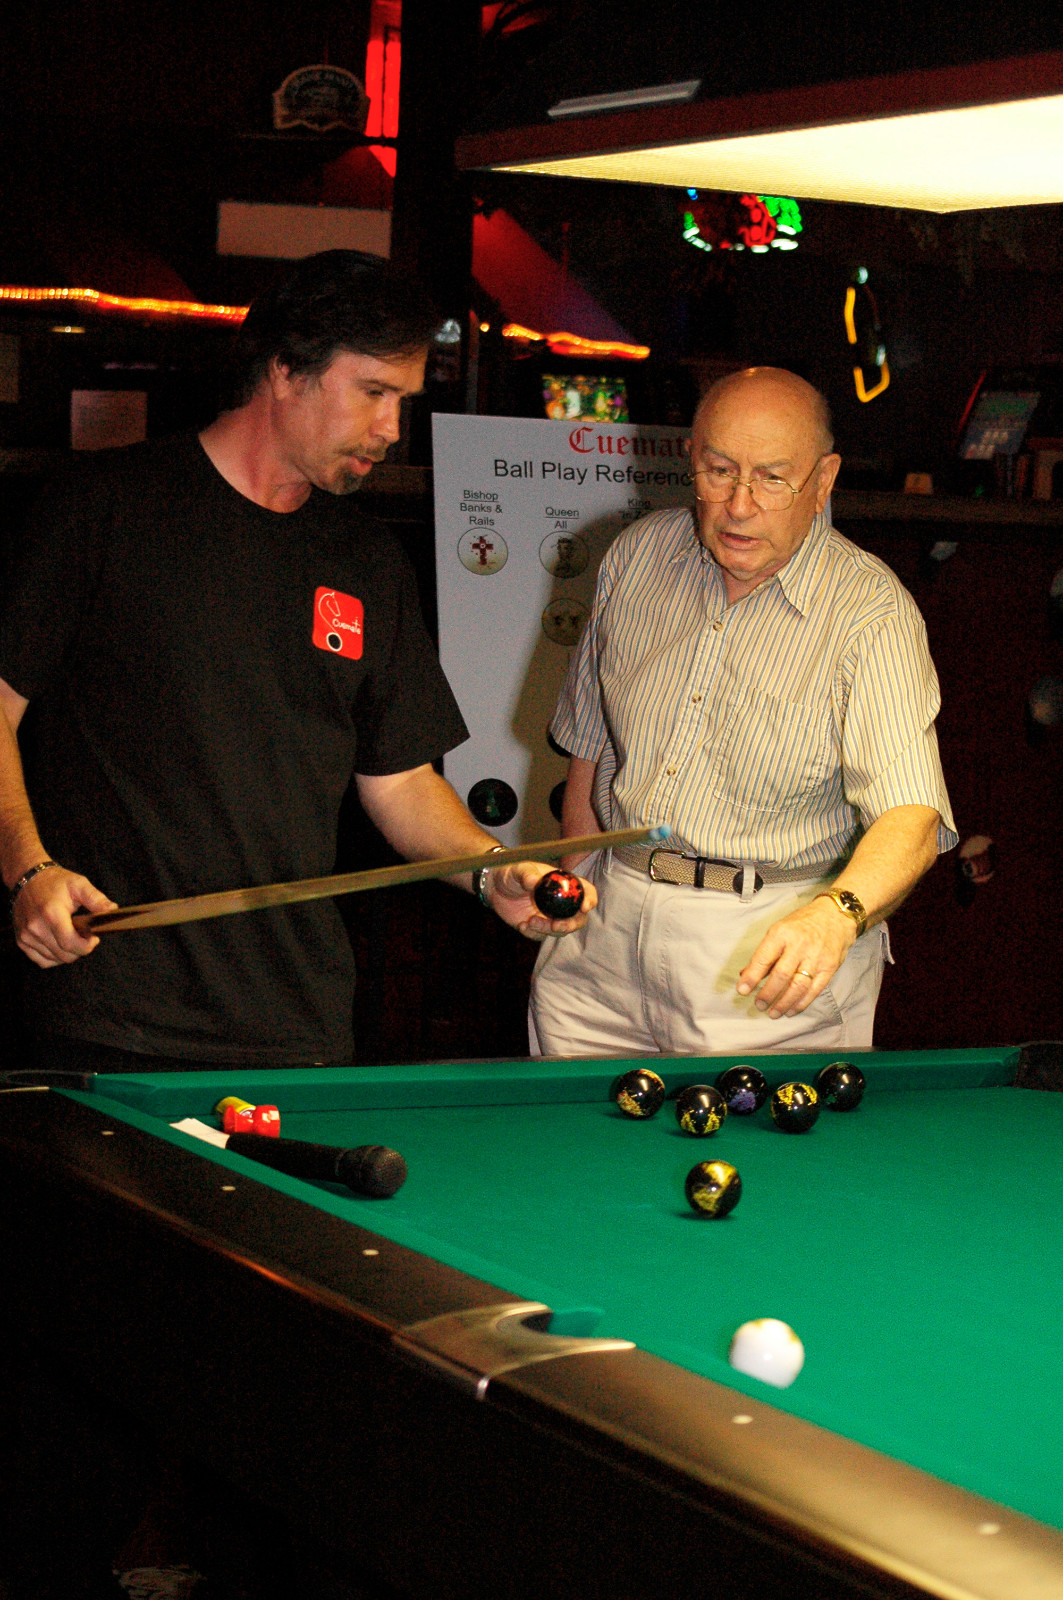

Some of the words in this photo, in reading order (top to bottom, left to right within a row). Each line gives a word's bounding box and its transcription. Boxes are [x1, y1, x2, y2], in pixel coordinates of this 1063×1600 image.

[569, 426, 686, 458] Cuemat
[494, 459, 533, 478] Ball
[542, 461, 588, 485] Play
[596, 464, 693, 487] Referenc
[463, 489, 499, 502] Bishop
[460, 502, 492, 513] Banks
[495, 504, 503, 514] &
[545, 506, 580, 517] Queen
[469, 515, 495, 526] Rails
[554, 520, 568, 529] All
